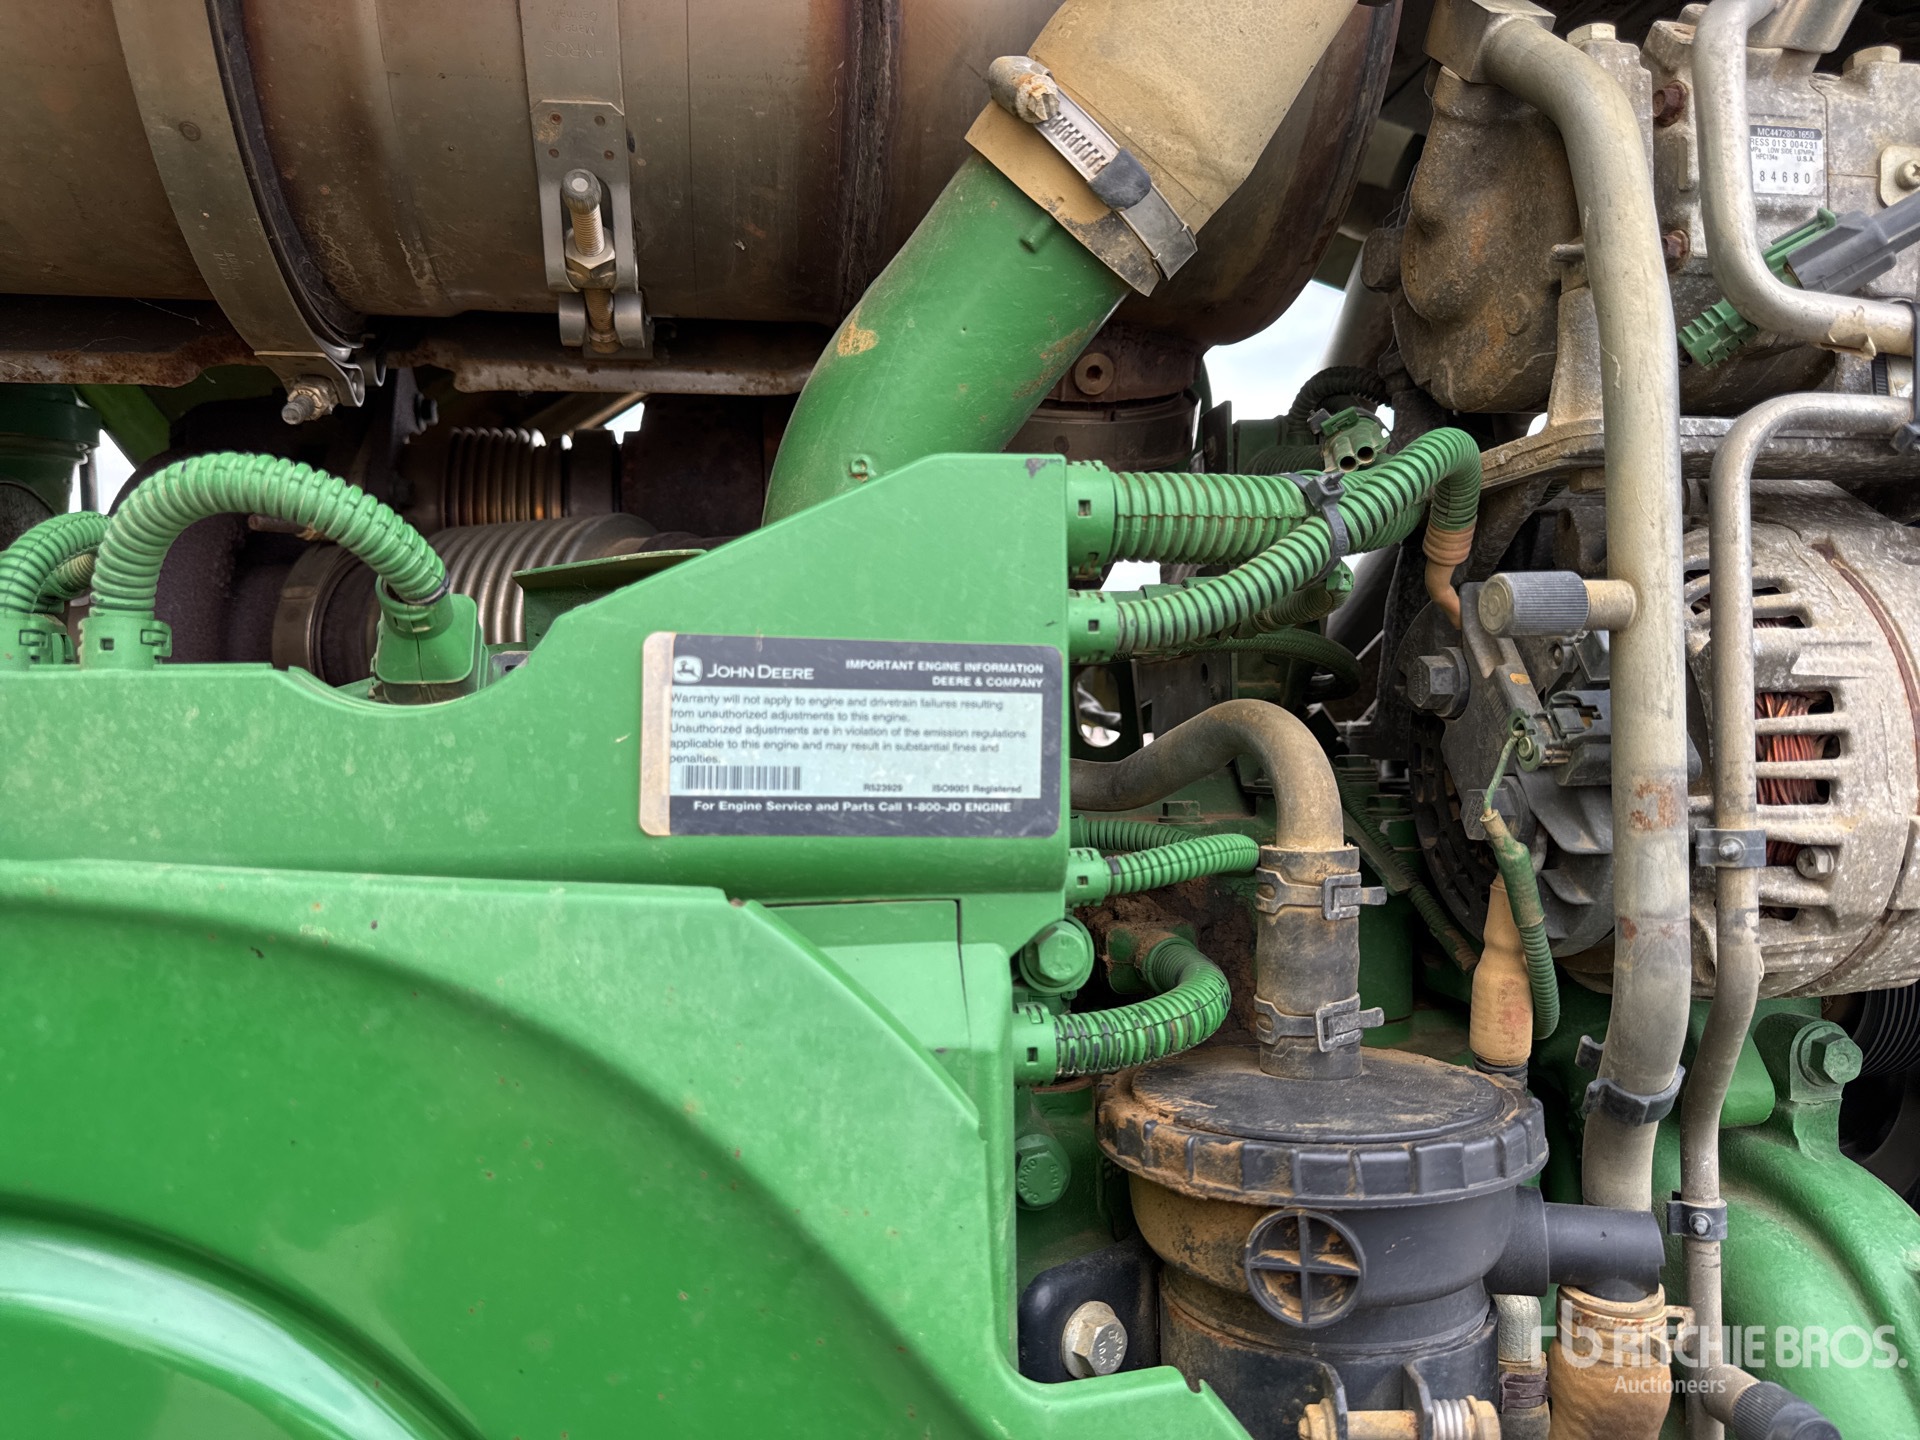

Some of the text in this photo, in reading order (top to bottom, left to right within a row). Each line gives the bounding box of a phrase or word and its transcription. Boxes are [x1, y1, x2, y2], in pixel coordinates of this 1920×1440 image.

[1757, 127, 1815, 139] MC447280-1650
[707, 663, 815, 680] JOHN DEERE
[846, 659, 1044, 674] IMPORTANT ENGINE INFORMATION
[932, 675, 1045, 688] DEERE & COMPANY
[671, 693, 1003, 711] Warranty will not apply to engine and drivetrain failures resulting
[671, 709, 910, 724] from unauthorized adjustments to this engine.
[671, 724, 1027, 741] Unauthorized adjustments are in violation of the emission regulations
[670, 738, 999, 753] applicable to this engine and may result in substantial fines and
[670, 753, 721, 765] penalties.
[932, 784, 1022, 795] ISO9001 Registered
[693, 800, 1012, 813] For Engine Service and Parts Call 1-800-JD ENGINE
